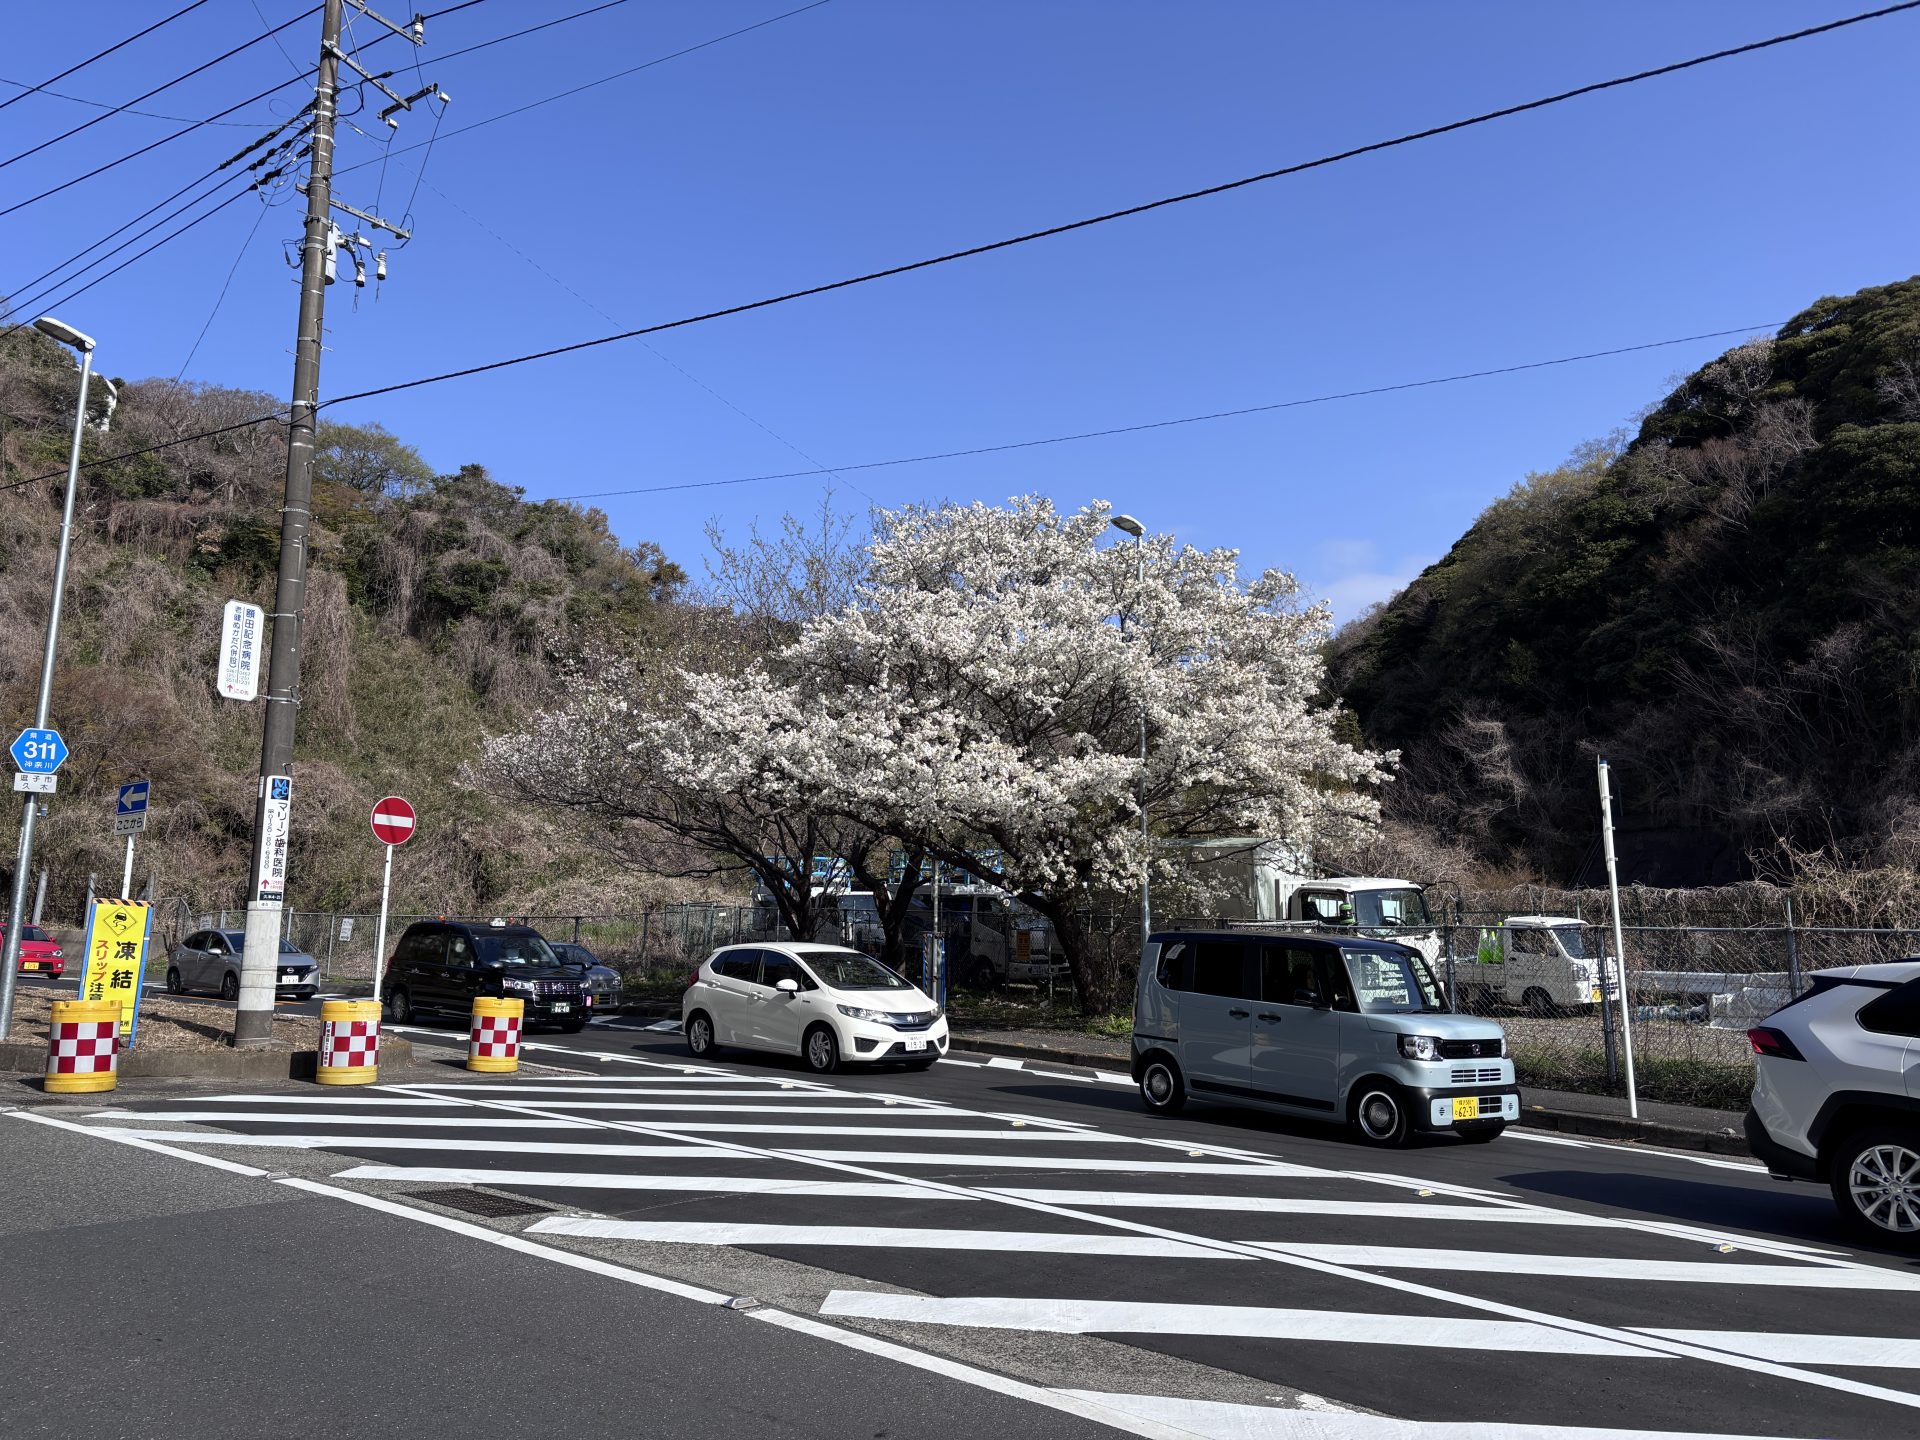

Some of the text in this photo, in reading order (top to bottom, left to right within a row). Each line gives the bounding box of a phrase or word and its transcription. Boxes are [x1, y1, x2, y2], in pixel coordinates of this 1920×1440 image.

[23, 741, 56, 760] 311
[24, 761, 53, 769] 神奈川
[116, 817, 143, 830] ここから
[272, 802, 288, 878] マリーン歯科医院
[110, 941, 137, 989] 凍結
